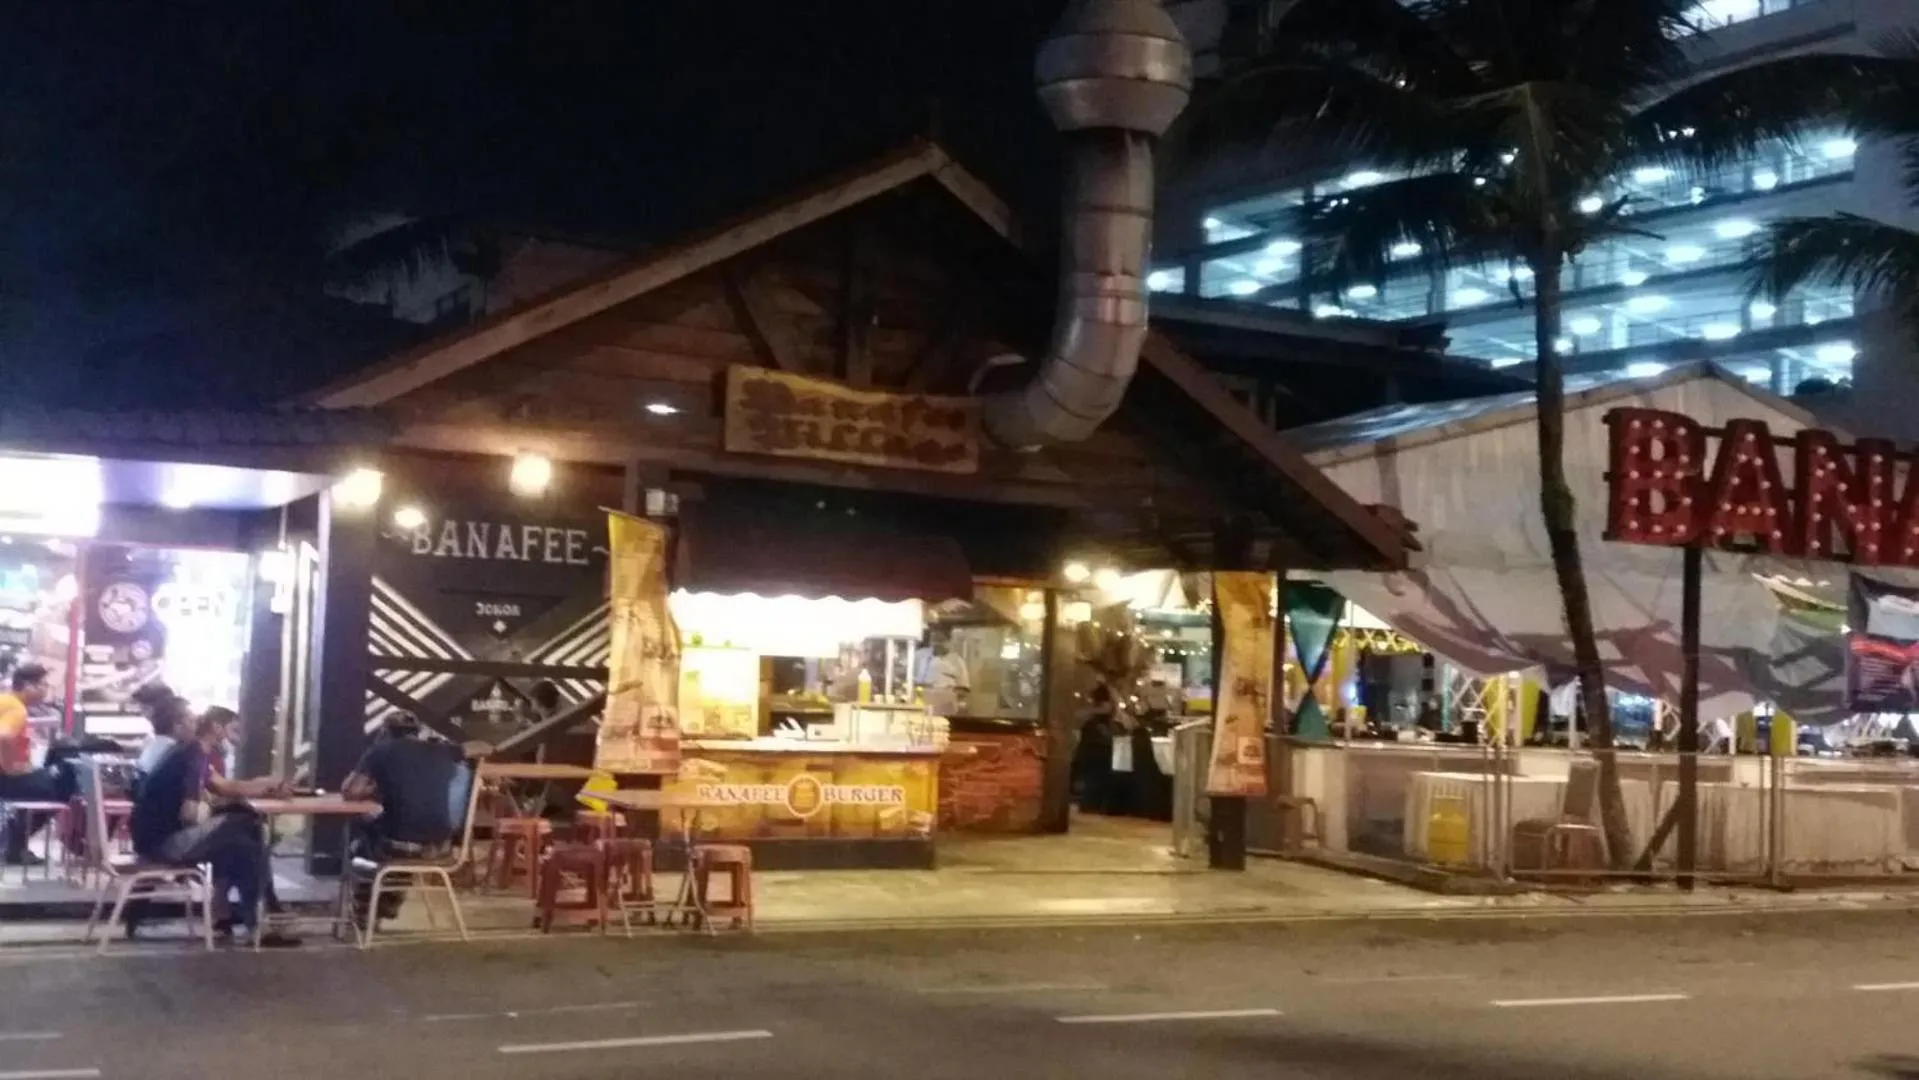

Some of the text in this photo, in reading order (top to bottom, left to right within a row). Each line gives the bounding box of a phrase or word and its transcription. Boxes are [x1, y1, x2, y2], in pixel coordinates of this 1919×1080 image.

[1602, 406, 1919, 568] BAN
[411, 519, 589, 565] BANAFEE
[821, 785, 904, 803] BURGER
